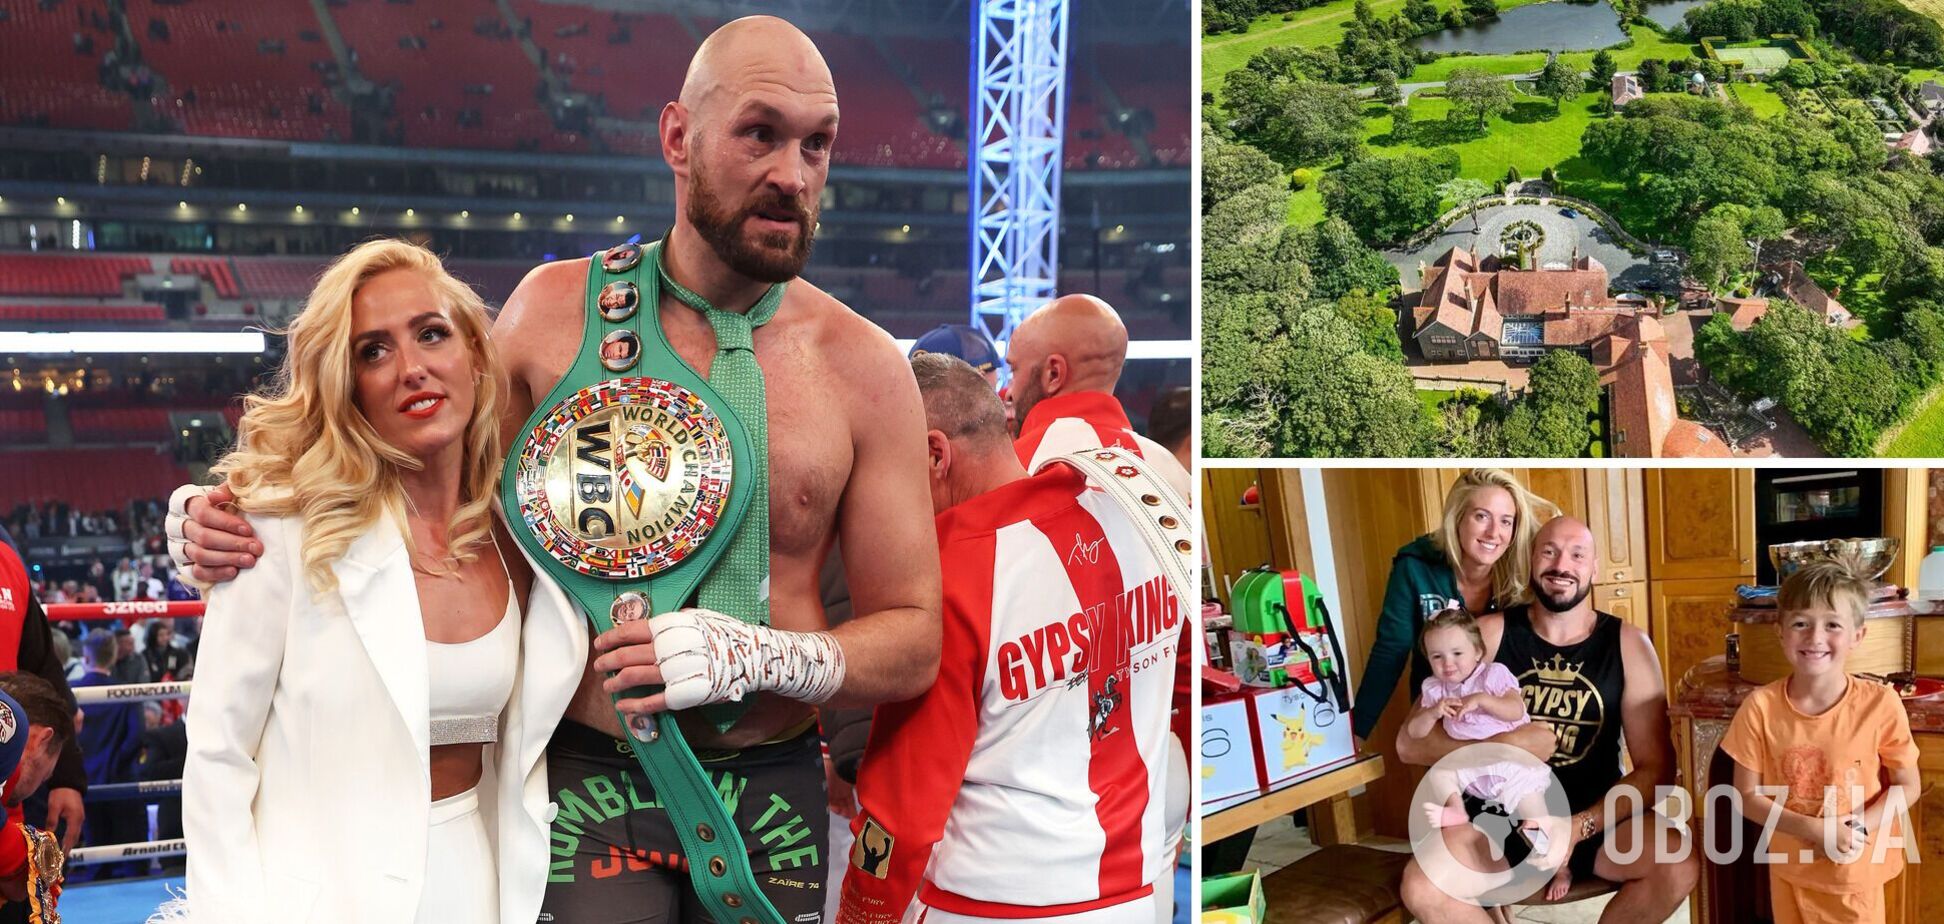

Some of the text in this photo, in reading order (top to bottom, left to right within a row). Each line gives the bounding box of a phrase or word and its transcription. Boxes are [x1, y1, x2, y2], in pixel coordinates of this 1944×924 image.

[576, 421, 615, 537] WBC
[622, 406, 699, 545] WORLD CHAMPION
[998, 573, 1178, 701] GYPSY KING
[1116, 653, 1158, 682] TYSON
[1521, 684, 1592, 721] GYPSY
[123, 843, 170, 856] Arnold
[751, 793, 819, 871] THE
[768, 877, 805, 889] ZAÏRE
